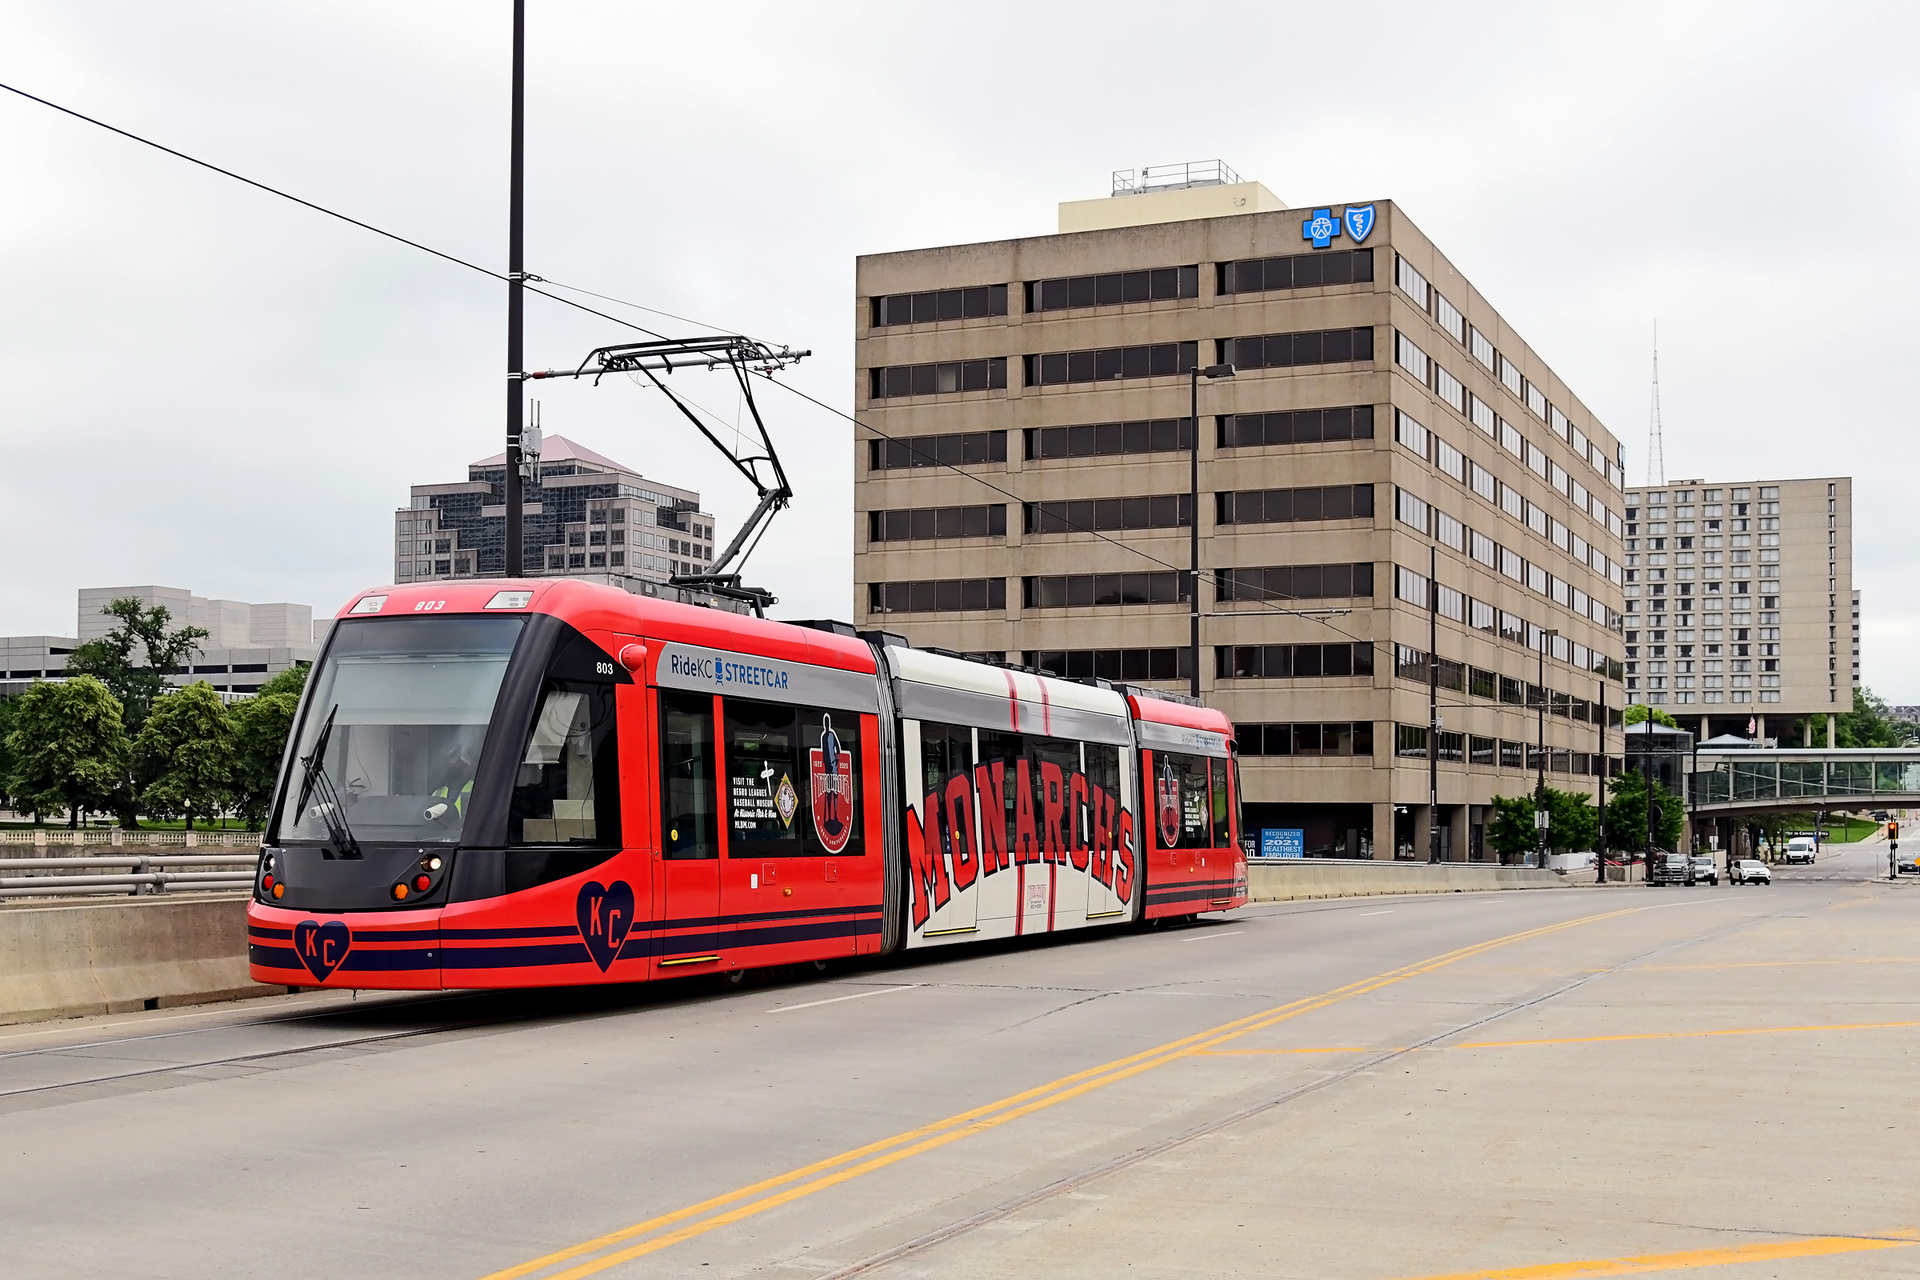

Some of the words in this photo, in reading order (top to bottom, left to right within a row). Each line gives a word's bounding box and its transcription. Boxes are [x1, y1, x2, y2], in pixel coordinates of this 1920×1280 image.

[414, 600, 446, 611] 803
[596, 662, 614, 675] 803
[671, 654, 713, 679] RideKC
[725, 662, 788, 689] STREETCAR
[732, 776, 744, 786] VISIT
[746, 778, 755, 786] THE
[733, 788, 748, 796] NEGRO
[748, 788, 767, 797] LEAGUES
[733, 798, 755, 807] BASEBALL
[756, 799, 774, 808] MUSEUM
[735, 820, 756, 829] NLBM.COM
[906, 755, 1134, 932] MONARCHS
[1244, 840, 1256, 848] FOR
[590, 896, 621, 948] KC
[306, 929, 336, 966] KC
